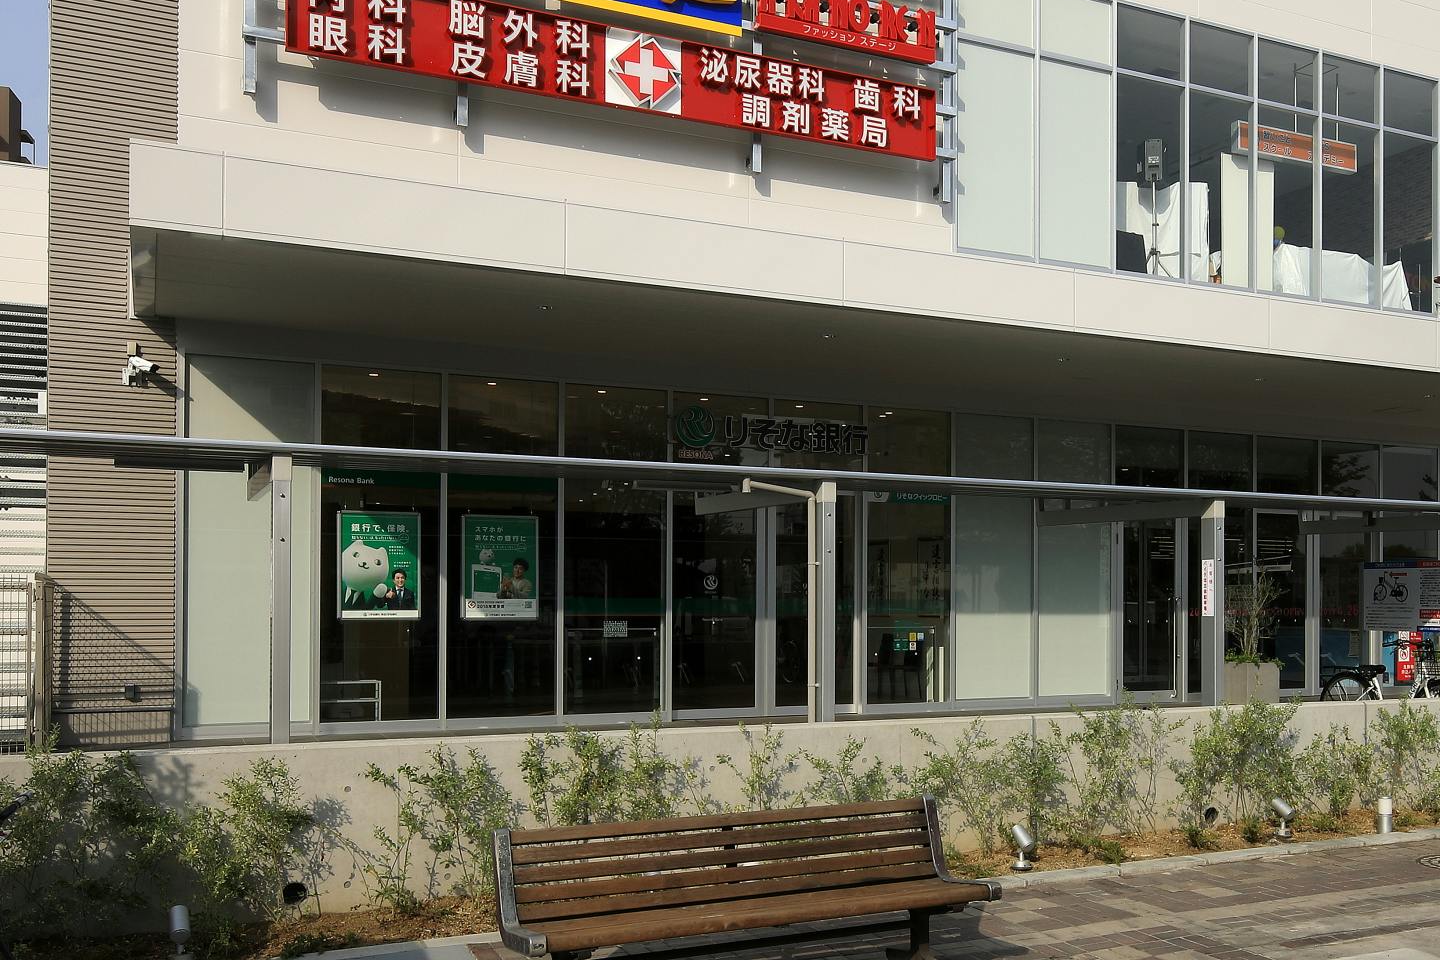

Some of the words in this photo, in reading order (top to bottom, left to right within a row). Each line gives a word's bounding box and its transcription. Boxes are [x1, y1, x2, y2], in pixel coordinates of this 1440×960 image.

[449, 0, 591, 58] 脳外科
[802, 24, 857, 44] ファッション
[859, 35, 897, 51] ステージ
[450, 41, 591, 96] 皮膚科
[699, 47, 825, 103] 泌尿器科
[853, 79, 921, 120] 歯科
[741, 93, 888, 148] 調剤薬局
[1262, 142, 1324, 157] スクール
[678, 448, 714, 460] RESONA
[724, 415, 869, 455] りそな銀行
[328, 475, 355, 484] Resona
[356, 477, 375, 485] Bank
